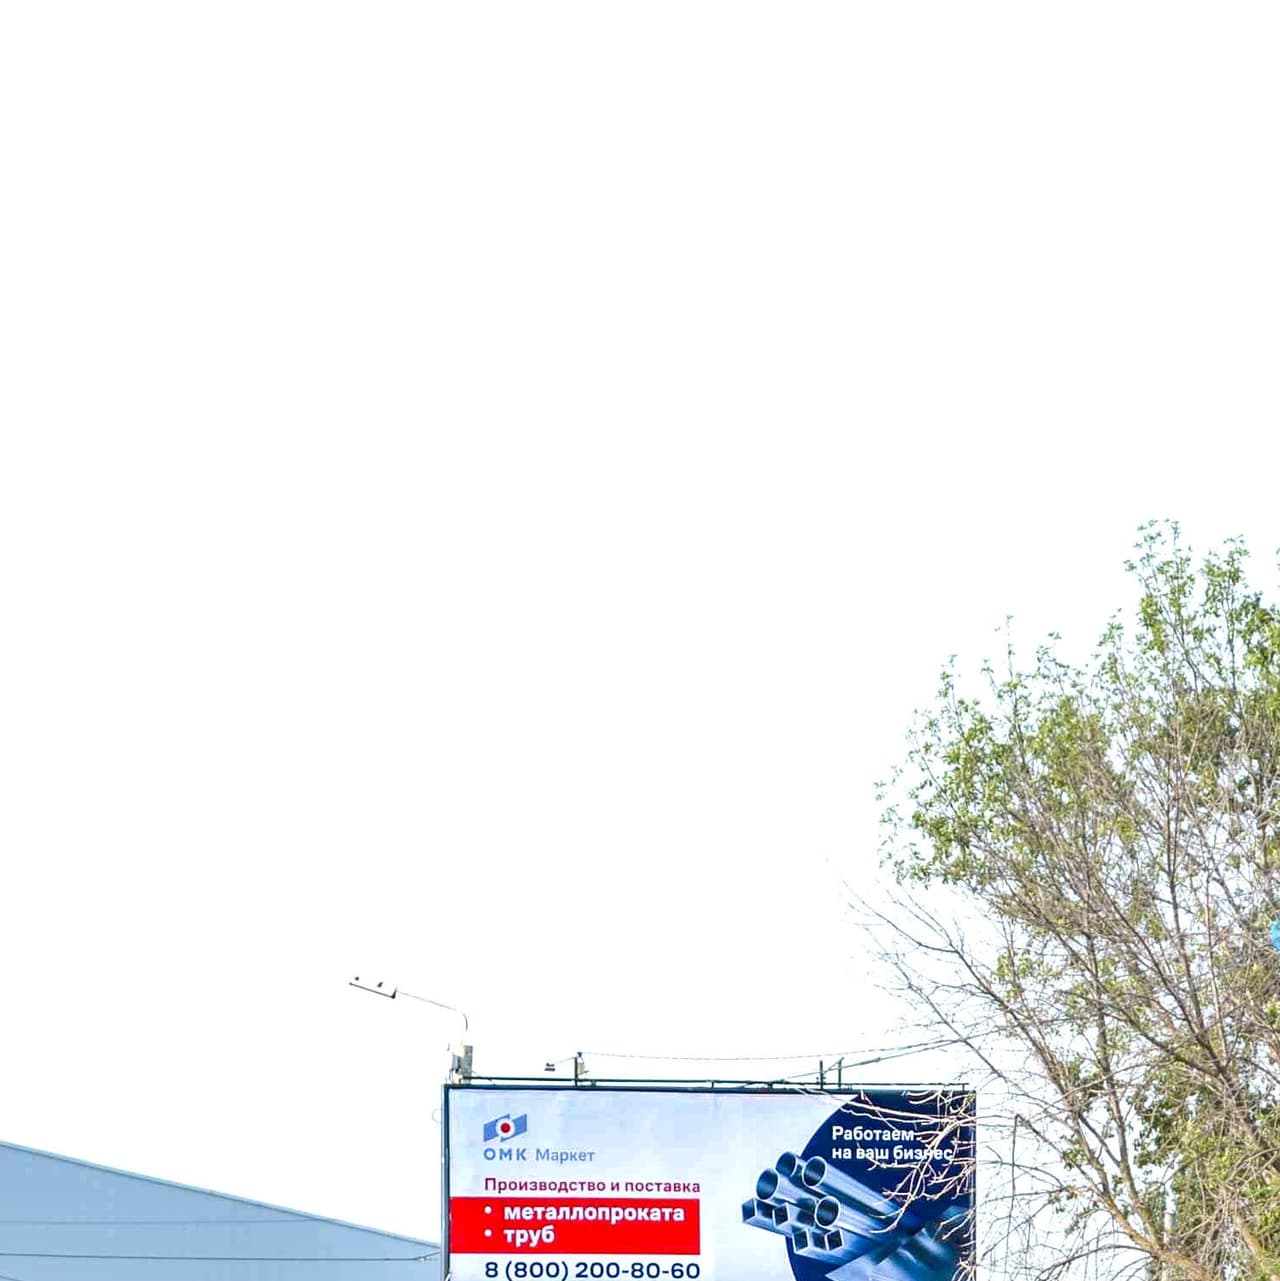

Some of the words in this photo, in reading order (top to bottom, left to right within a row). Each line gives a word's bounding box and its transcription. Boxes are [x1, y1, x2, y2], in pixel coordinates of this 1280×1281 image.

[831, 1125, 914, 1141] Работаем
[483, 1147, 528, 1161] ОМК
[535, 1148, 596, 1164] Маркет
[832, 1148, 852, 1159] на
[856, 1147, 889, 1160] ваш
[893, 1145, 954, 1160] бизнес
[484, 1177, 606, 1194] Производство
[610, 1181, 620, 1192] и
[624, 1181, 701, 1193] поставка
[503, 1205, 686, 1225] металлопроката
[503, 1225, 555, 1246] труб
[484, 1261, 499, 1279] 8
[505, 1260, 569, 1281] (800)
[575, 1261, 701, 1281] 200-80-60
